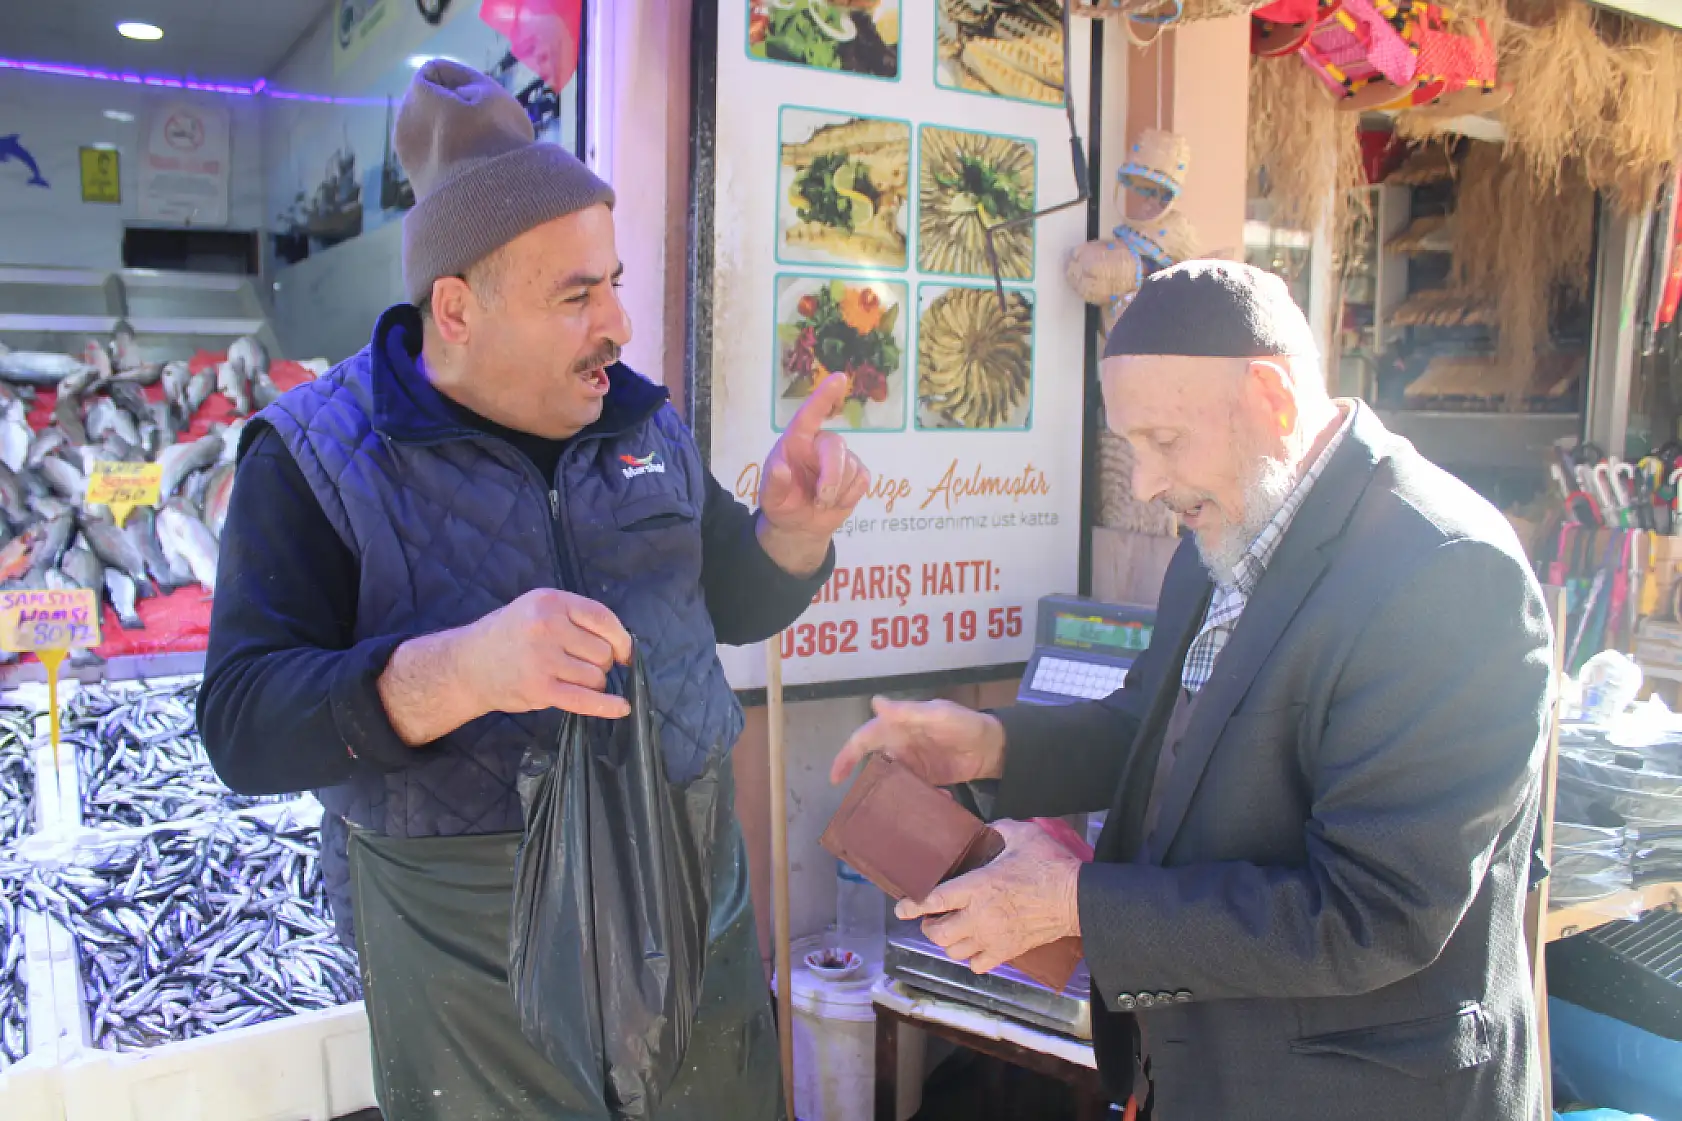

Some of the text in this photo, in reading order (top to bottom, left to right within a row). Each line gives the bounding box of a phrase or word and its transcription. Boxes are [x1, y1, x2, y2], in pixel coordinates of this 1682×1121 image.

[1020, 510, 1060, 527] katta
[921, 560, 1000, 597] HATTI:
[780, 605, 1022, 660] 0362 503 19 55
